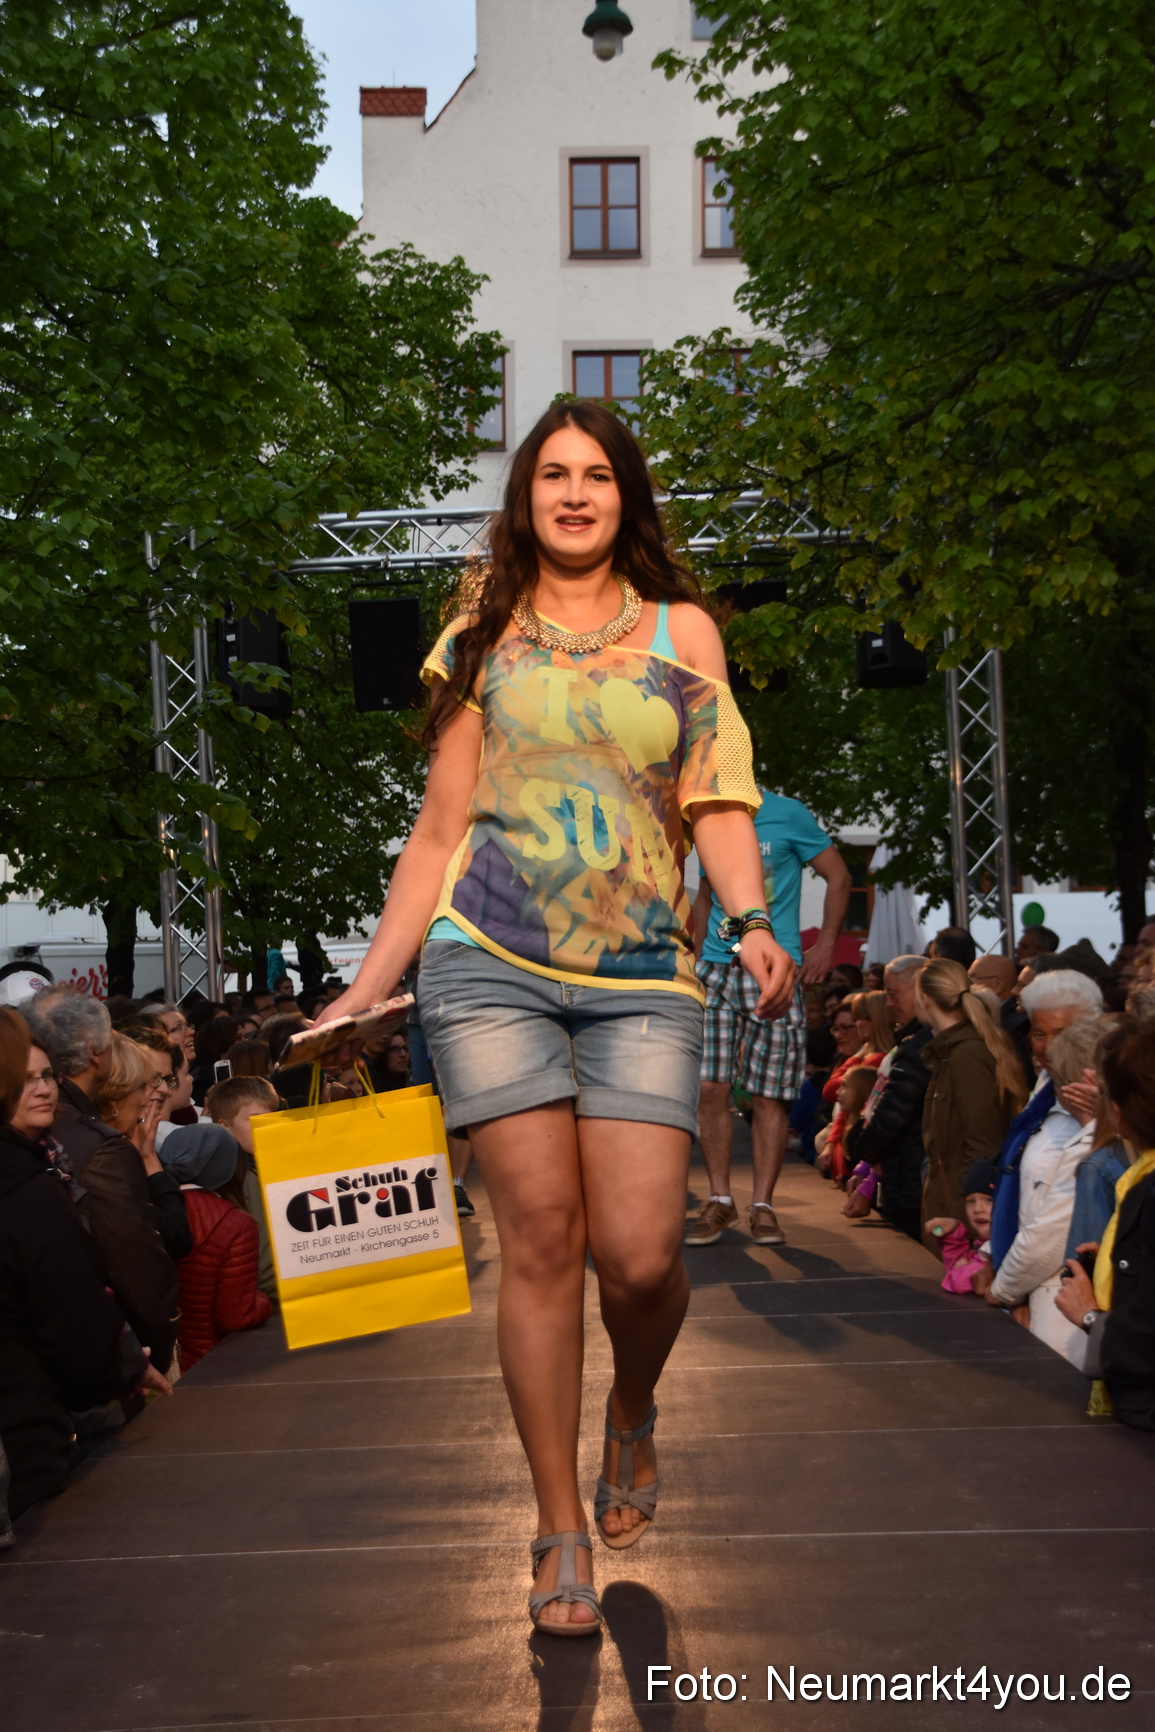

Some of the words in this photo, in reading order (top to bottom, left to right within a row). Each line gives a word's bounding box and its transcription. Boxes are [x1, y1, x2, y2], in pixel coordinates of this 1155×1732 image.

[519, 779, 674, 902] SUN
[335, 1167, 408, 1193] Schuh
[291, 1241, 309, 1253] ZEIT
[313, 1237, 332, 1248] FÜR
[335, 1231, 364, 1244] EINEN
[367, 1224, 401, 1238] GUTEN
[404, 1216, 439, 1231] SCHUH
[300, 1247, 351, 1264] Neumarkt
[360, 1233, 429, 1252] Kirchengasse
[433, 1230, 439, 1239] 5
